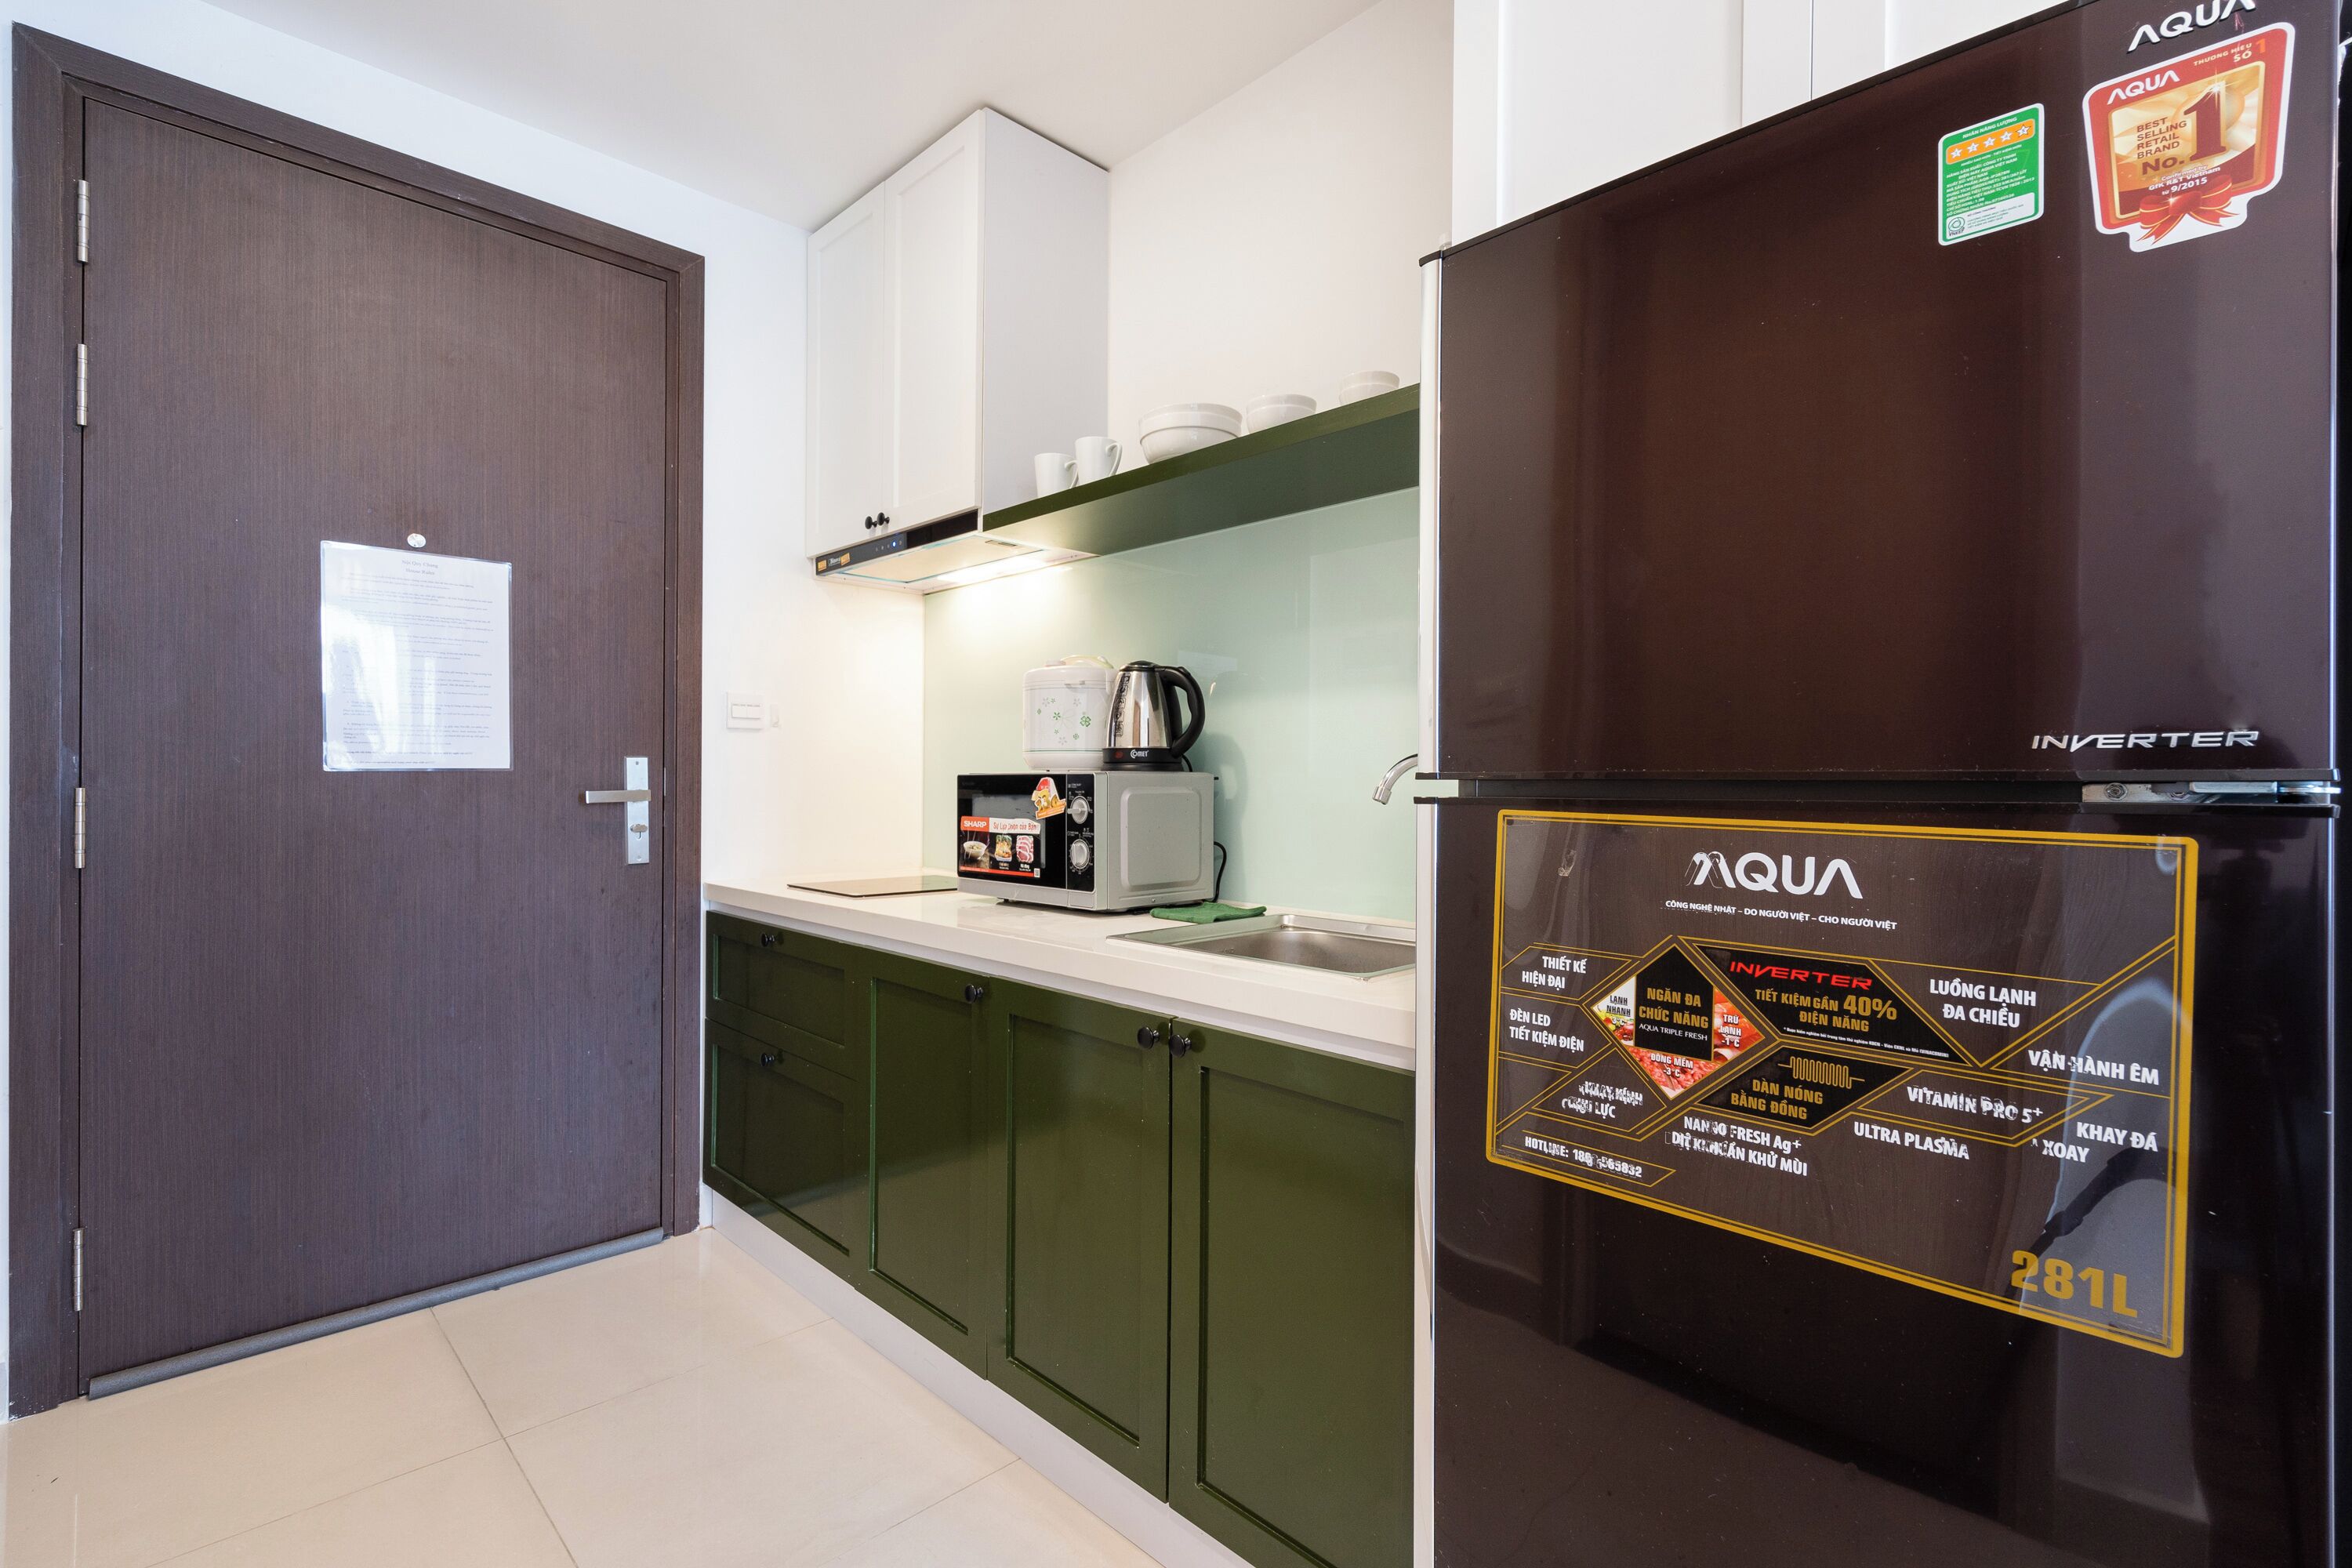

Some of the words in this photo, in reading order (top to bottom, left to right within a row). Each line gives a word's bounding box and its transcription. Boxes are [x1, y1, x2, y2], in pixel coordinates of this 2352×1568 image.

[2126, 0, 2256, 53] AQUA
[2107, 70, 2180, 105] AQUA
[2137, 117, 2168, 132] BEST
[2137, 120, 2187, 141] SELLING
[2137, 132, 2180, 151] RETAIL
[2137, 141, 2180, 159] BRAND
[2187, 166, 2221, 180] Vietnam
[2171, 177, 2208, 193] 9/2015
[2032, 731, 2259, 753] INVERTER
[1686, 851, 1864, 899] AQUA
[1665, 900, 1688, 909] CÔNG
[1744, 908, 1758, 916] DO
[1759, 909, 1788, 919] NGƯỜI
[1790, 912, 1810, 922] VIỆT
[1818, 915, 1838, 924] CHO
[1841, 917, 1874, 927] NGƯỜI
[1875, 920, 1897, 931] VIỆT
[1542, 956, 1571, 971] THIẾT
[1573, 958, 1588, 974] KẾ
[1730, 960, 1872, 990] INVERTER
[1522, 971, 1545, 987] HIỆN
[1548, 975, 1566, 991] ĐẠI
[1930, 978, 1985, 1000] LUỒNG
[1989, 985, 2037, 1007] LẠNH
[1610, 995, 1628, 1006] LẠNH
[1646, 987, 1681, 1004] NGĂN
[1685, 993, 1701, 1007] ĐA
[1755, 988, 1778, 1003] TIẾT
[1781, 993, 1811, 1007] KIỆM
[1813, 996, 1838, 1011] GẦN
[1843, 995, 1897, 1021] 40%
[1509, 1007, 1530, 1023] ĐÈN
[1532, 1012, 1551, 1027] LED
[1606, 1004, 1631, 1017] NHANH
[1639, 1005, 1670, 1022] CHỨC
[1673, 1010, 1709, 1029] NĂNG
[1799, 1011, 1828, 1026] ĐIỆN
[1832, 1014, 1870, 1033] NĂNG
[1943, 1004, 1965, 1021] ĐA
[1969, 1007, 2020, 1028] CHIỀU
[1509, 1025, 1530, 1040] TIẾT
[1532, 1030, 1557, 1047] KIỆM
[1559, 1036, 1584, 1053] ĐIỆN
[1639, 1023, 1659, 1033] AQUA
[1661, 1026, 1683, 1036] TRIPLE
[1685, 1030, 1708, 1041] FRESH
[1720, 1025, 1742, 1036] LẠNH
[1650, 1053, 1671, 1065] ĐÔNG
[2028, 1049, 2066, 1072] VẬN
[2070, 1055, 2125, 1080] HÀNH
[2129, 1062, 2159, 1086] ÊM
[1752, 1077, 1780, 1096] DÀN
[1784, 1085, 1823, 1105] NÓNG
[1595, 1102, 1616, 1119] LỰC
[1731, 1089, 1766, 1111] BẰNG
[1770, 1099, 1807, 1120] ĐỒNG
[1907, 1086, 1977, 1113] VITAMIN
[1980, 1096, 2019, 1121] PRO
[1730, 1125, 1770, 1147] FRESH
[1854, 1121, 1901, 1145] ULTRA
[1904, 1132, 1970, 1160] PLASMA
[2077, 1122, 2128, 1145] KHAY
[2129, 1132, 2158, 1152] ĐÁ
[2042, 1139, 2090, 1163] XOAY
[1748, 1151, 1777, 1168] KHỬ
[1780, 1157, 1807, 1176] MÙI
[2011, 1250, 2138, 1318] 281L
